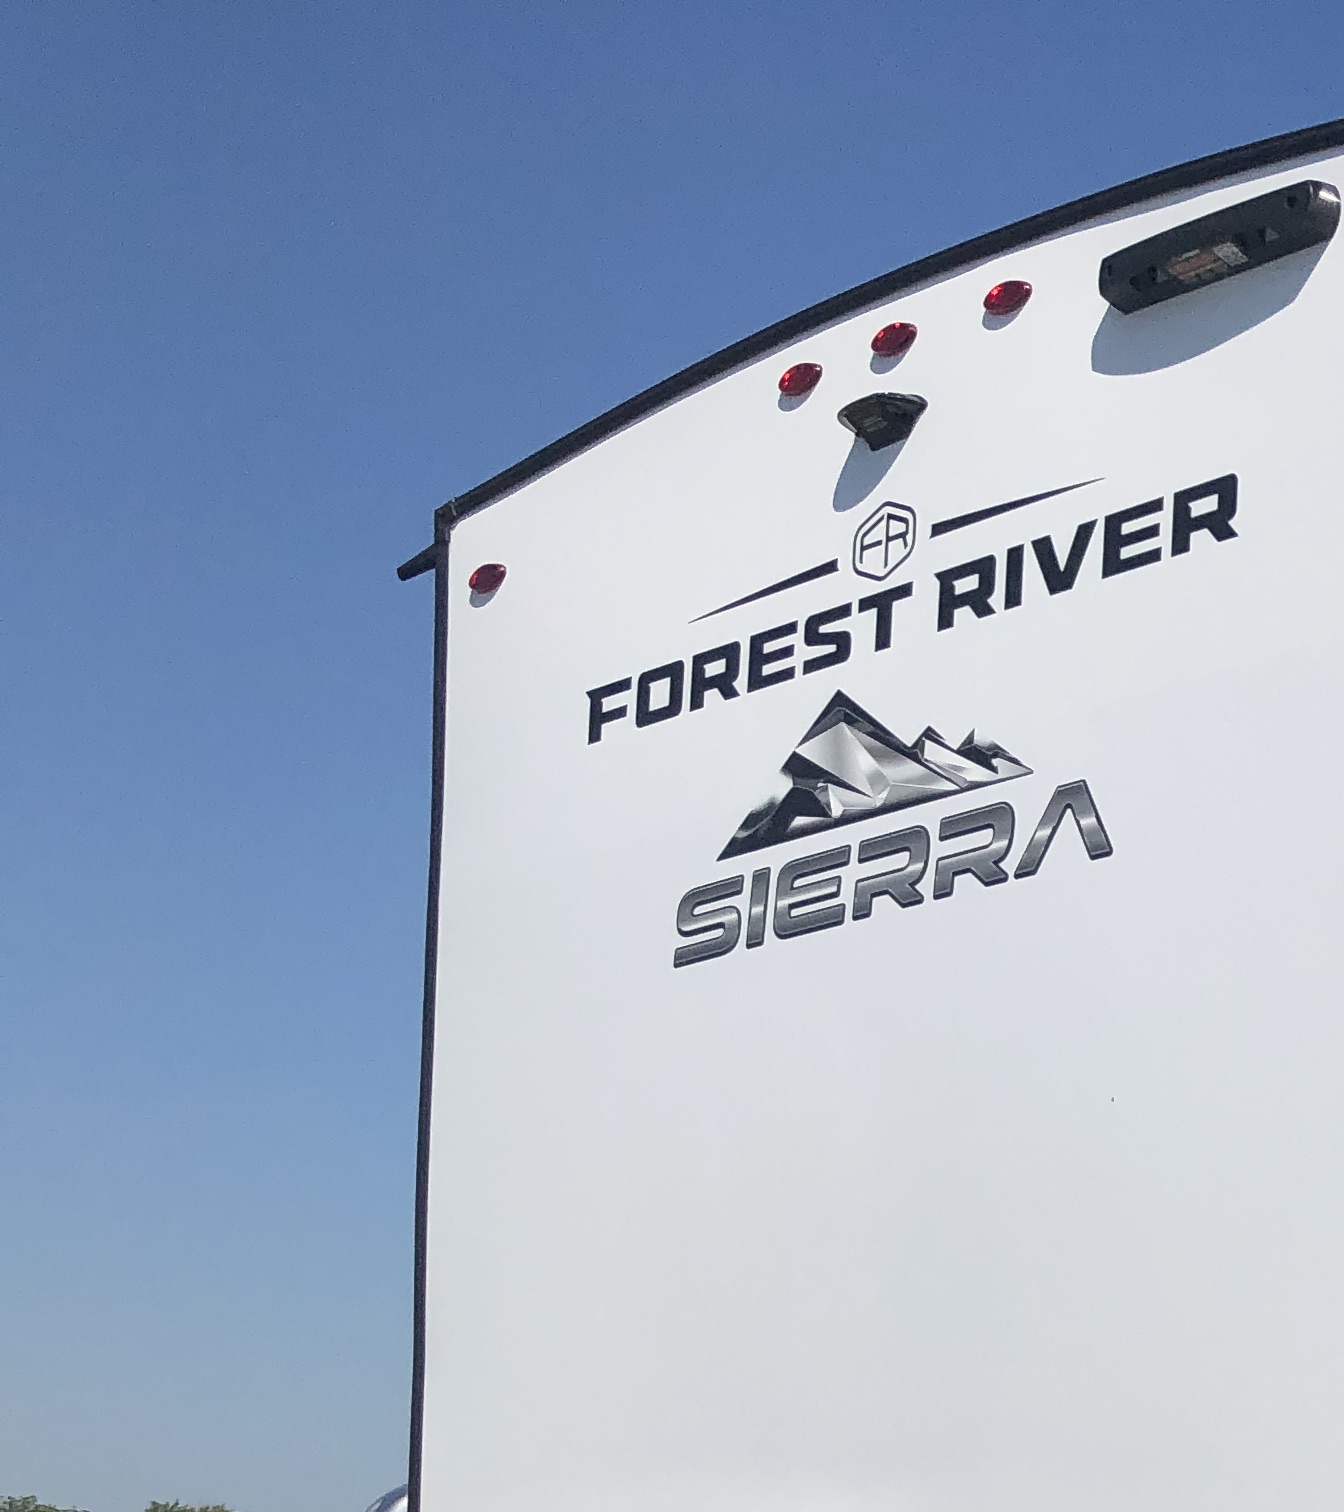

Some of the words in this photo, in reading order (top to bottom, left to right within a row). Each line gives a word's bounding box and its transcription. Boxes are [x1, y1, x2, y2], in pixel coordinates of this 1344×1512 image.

[586, 582, 913, 745] FOREST
[934, 472, 1238, 633] RIVER
[673, 779, 1113, 969] SIERRA
